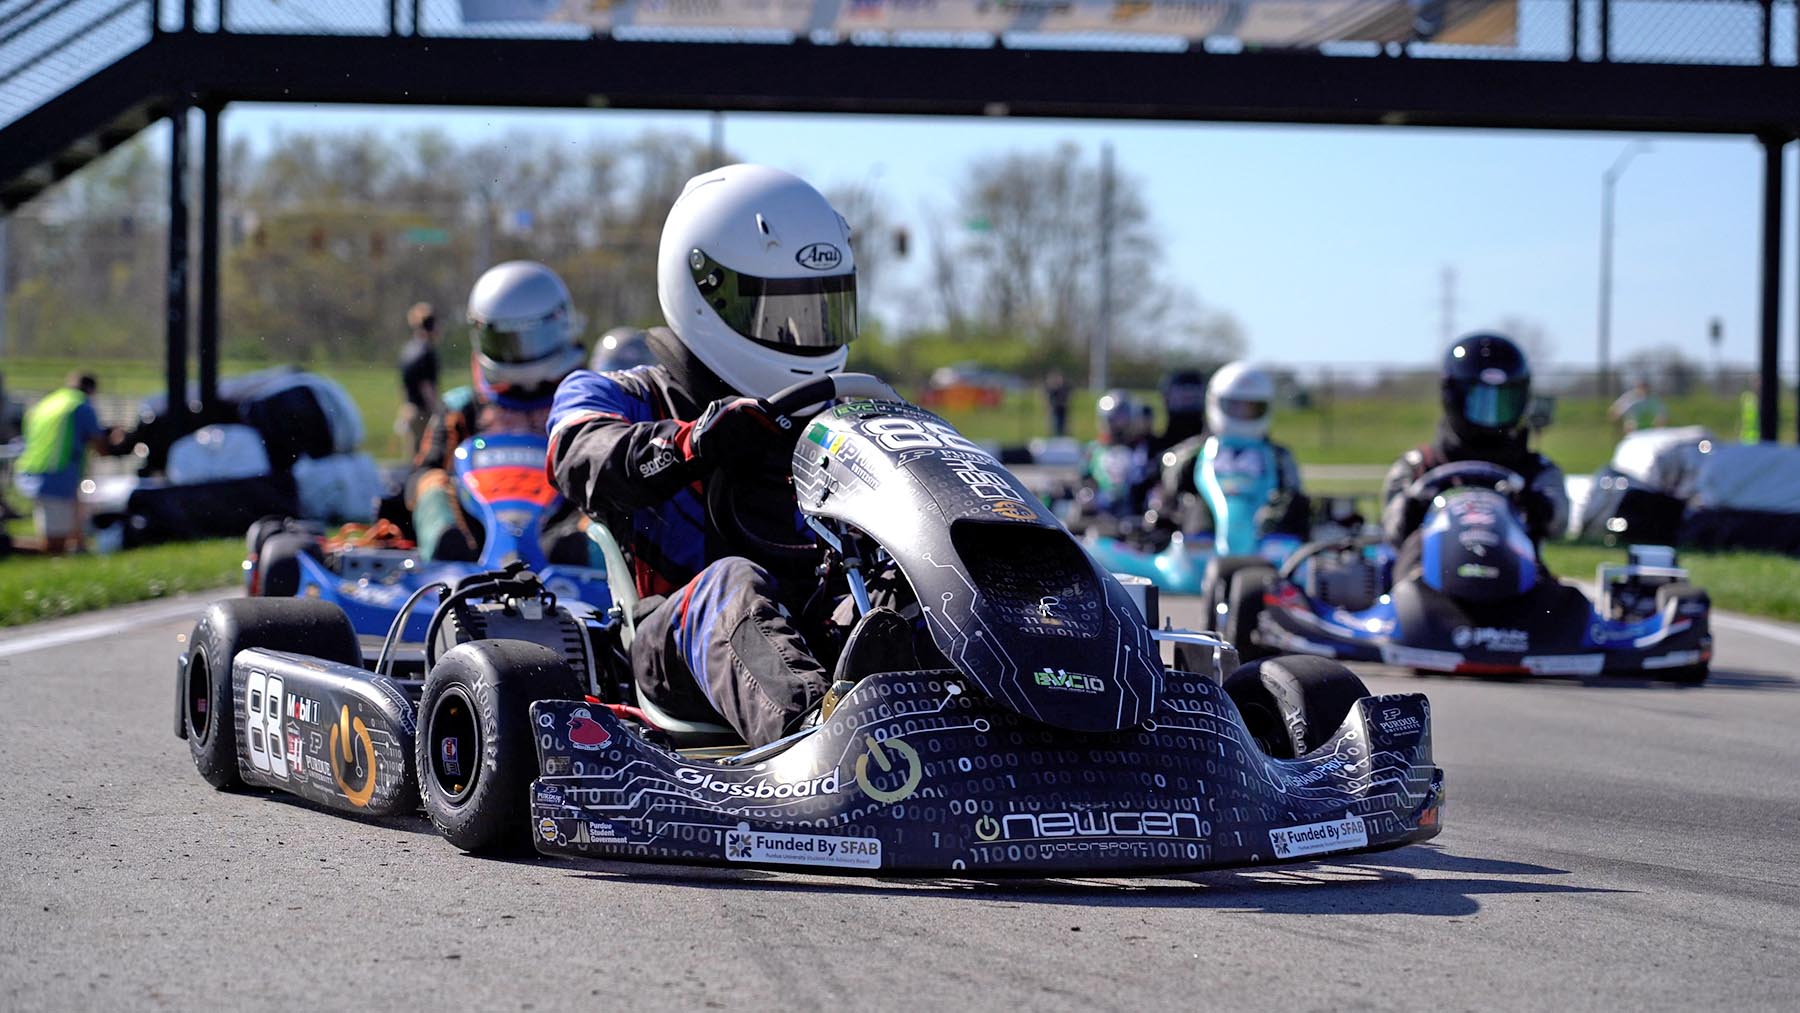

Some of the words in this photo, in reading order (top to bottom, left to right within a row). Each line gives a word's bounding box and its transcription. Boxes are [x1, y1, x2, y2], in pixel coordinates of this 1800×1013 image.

[800, 246, 837, 262] Arai
[286, 693, 311, 722] Mobil
[246, 666, 288, 780] 88
[1380, 716, 1419, 730] PURDUE
[305, 755, 332, 777] PURDUE
[675, 766, 841, 798] Glassboard
[589, 821, 612, 830] Purdue
[590, 828, 615, 837] Student
[1287, 826, 1327, 844] Funded
[1326, 825, 1340, 840] By
[1340, 821, 1364, 836] SFAB
[591, 835, 628, 844] Government
[756, 836, 814, 852] Funded
[818, 839, 837, 856] By
[840, 841, 879, 856] SFAB
[1040, 841, 1149, 852] motorsport
